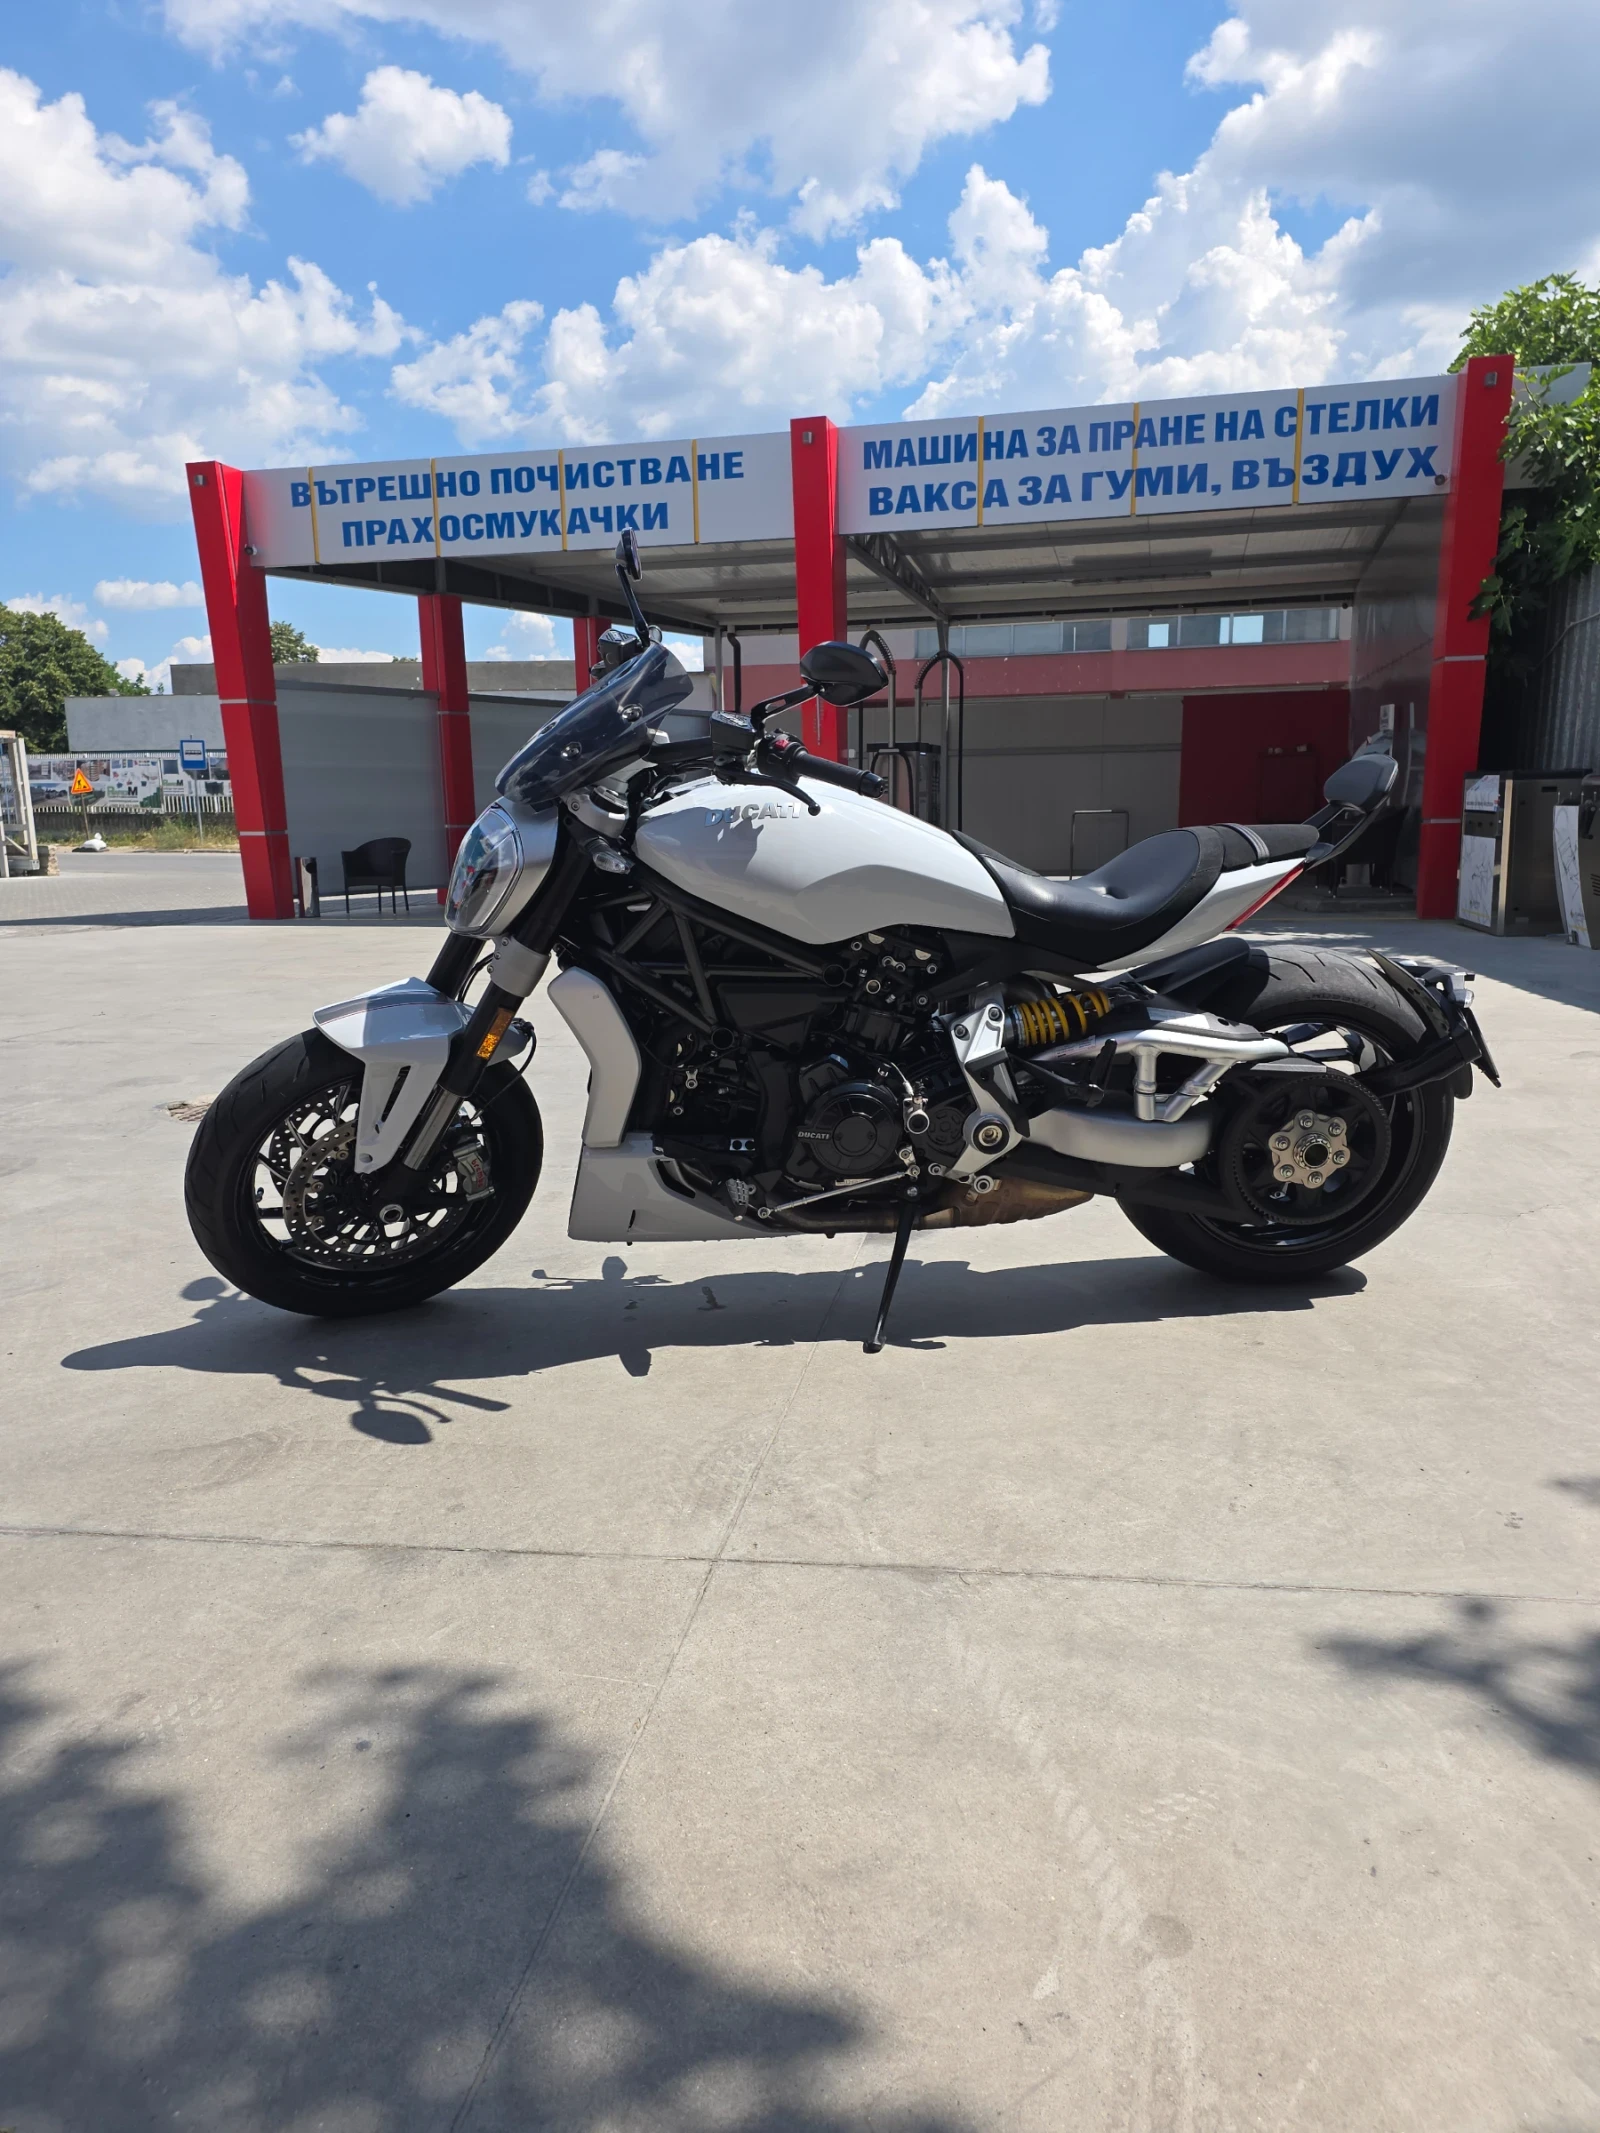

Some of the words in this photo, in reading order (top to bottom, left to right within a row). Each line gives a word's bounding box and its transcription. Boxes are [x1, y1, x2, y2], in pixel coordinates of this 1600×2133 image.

[863, 429, 1029, 470] МАШИНА
[1036, 425, 1081, 457] ЗА
[1089, 414, 1205, 453] ПРАНЕ
[1214, 409, 1265, 443] НА
[290, 470, 481, 507] ВЪТРЕШНО
[491, 451, 744, 495] ПОЧИСТВАНЕ
[869, 478, 1010, 516] ВАКСА
[1018, 474, 1072, 505] ЗА
[1081, 463, 1222, 502] ГУМИ,
[1231, 445, 1438, 491] ВЪЗДУХ
[342, 502, 669, 547] ПРАХОСМУКАЧКИ
[704, 802, 801, 828] DUCATI
[797, 1131, 830, 1140] DUCATI
